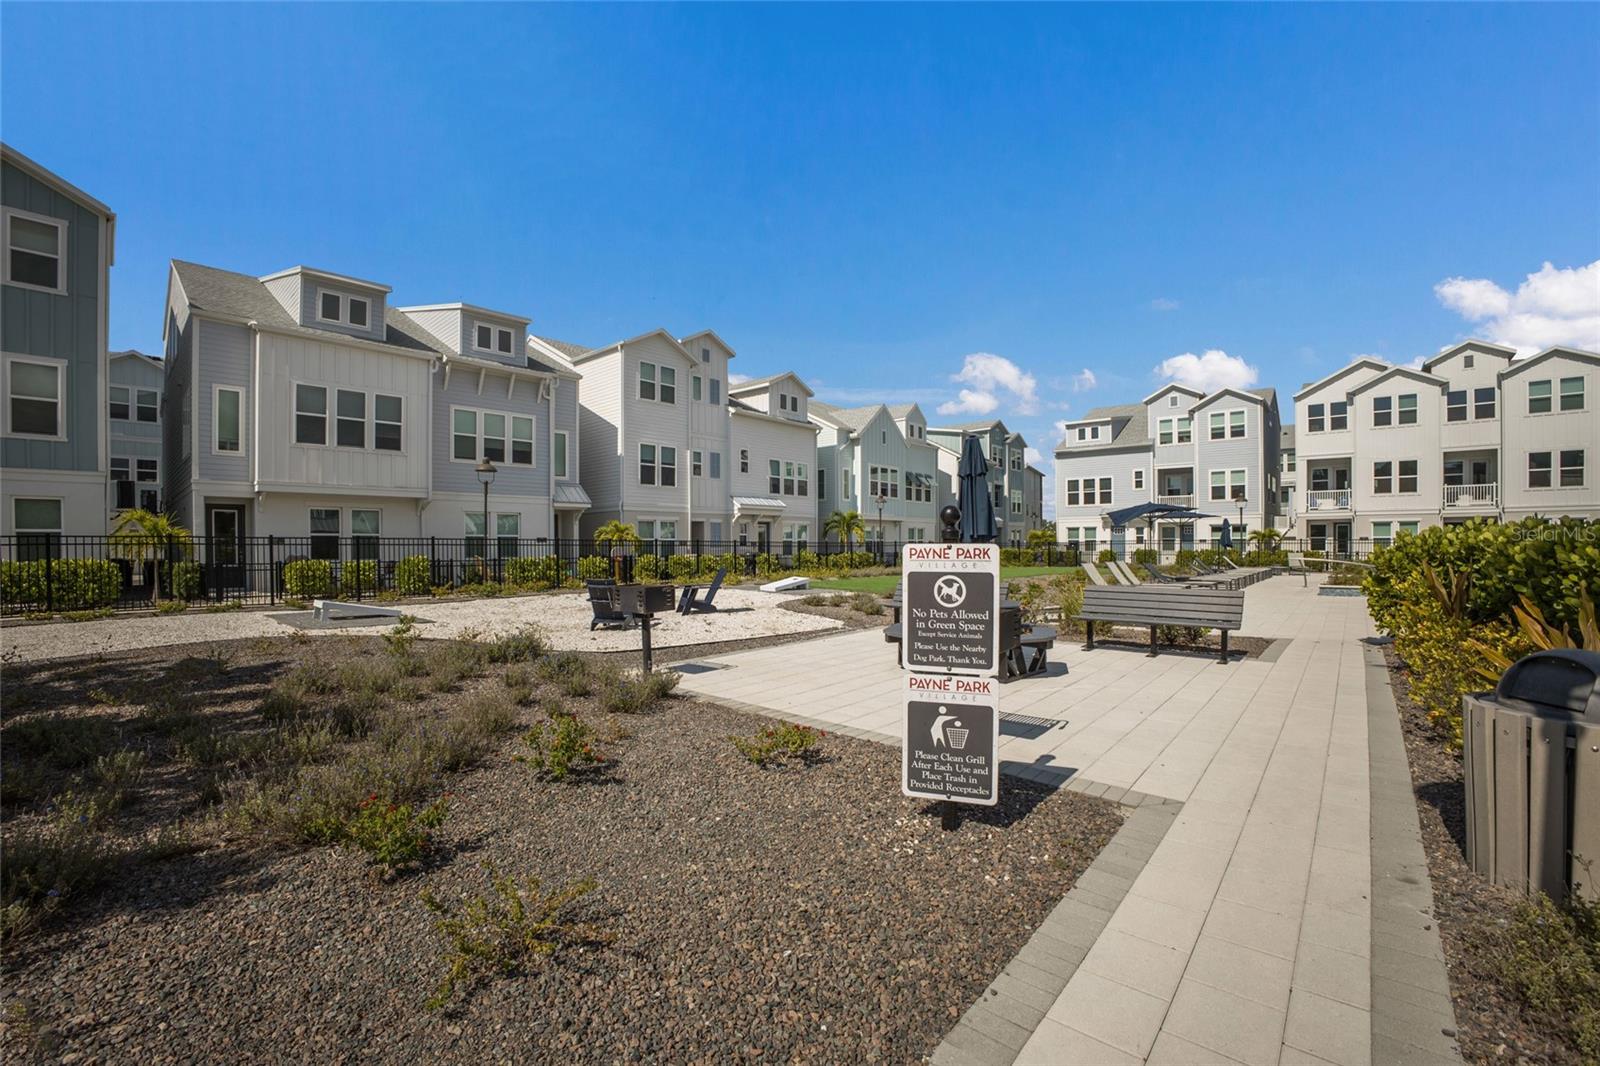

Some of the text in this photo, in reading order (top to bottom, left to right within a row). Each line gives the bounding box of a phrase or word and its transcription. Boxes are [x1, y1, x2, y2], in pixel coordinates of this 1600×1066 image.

[909, 548, 990, 560] PAYNE PARK
[912, 608, 989, 620] No Pets Allowed
[916, 619, 985, 632] in Green Space
[962, 645, 987, 654] Nearby
[913, 654, 927, 662] Dog
[909, 677, 990, 693] PAYNE PARK
[920, 692, 977, 702] VILLAGE
[915, 750, 985, 764] Please Clean Grill
[912, 760, 988, 775] After Each Use and
[922, 771, 978, 784] Place Trash in
[910, 779, 989, 795] Provided Receptacles
